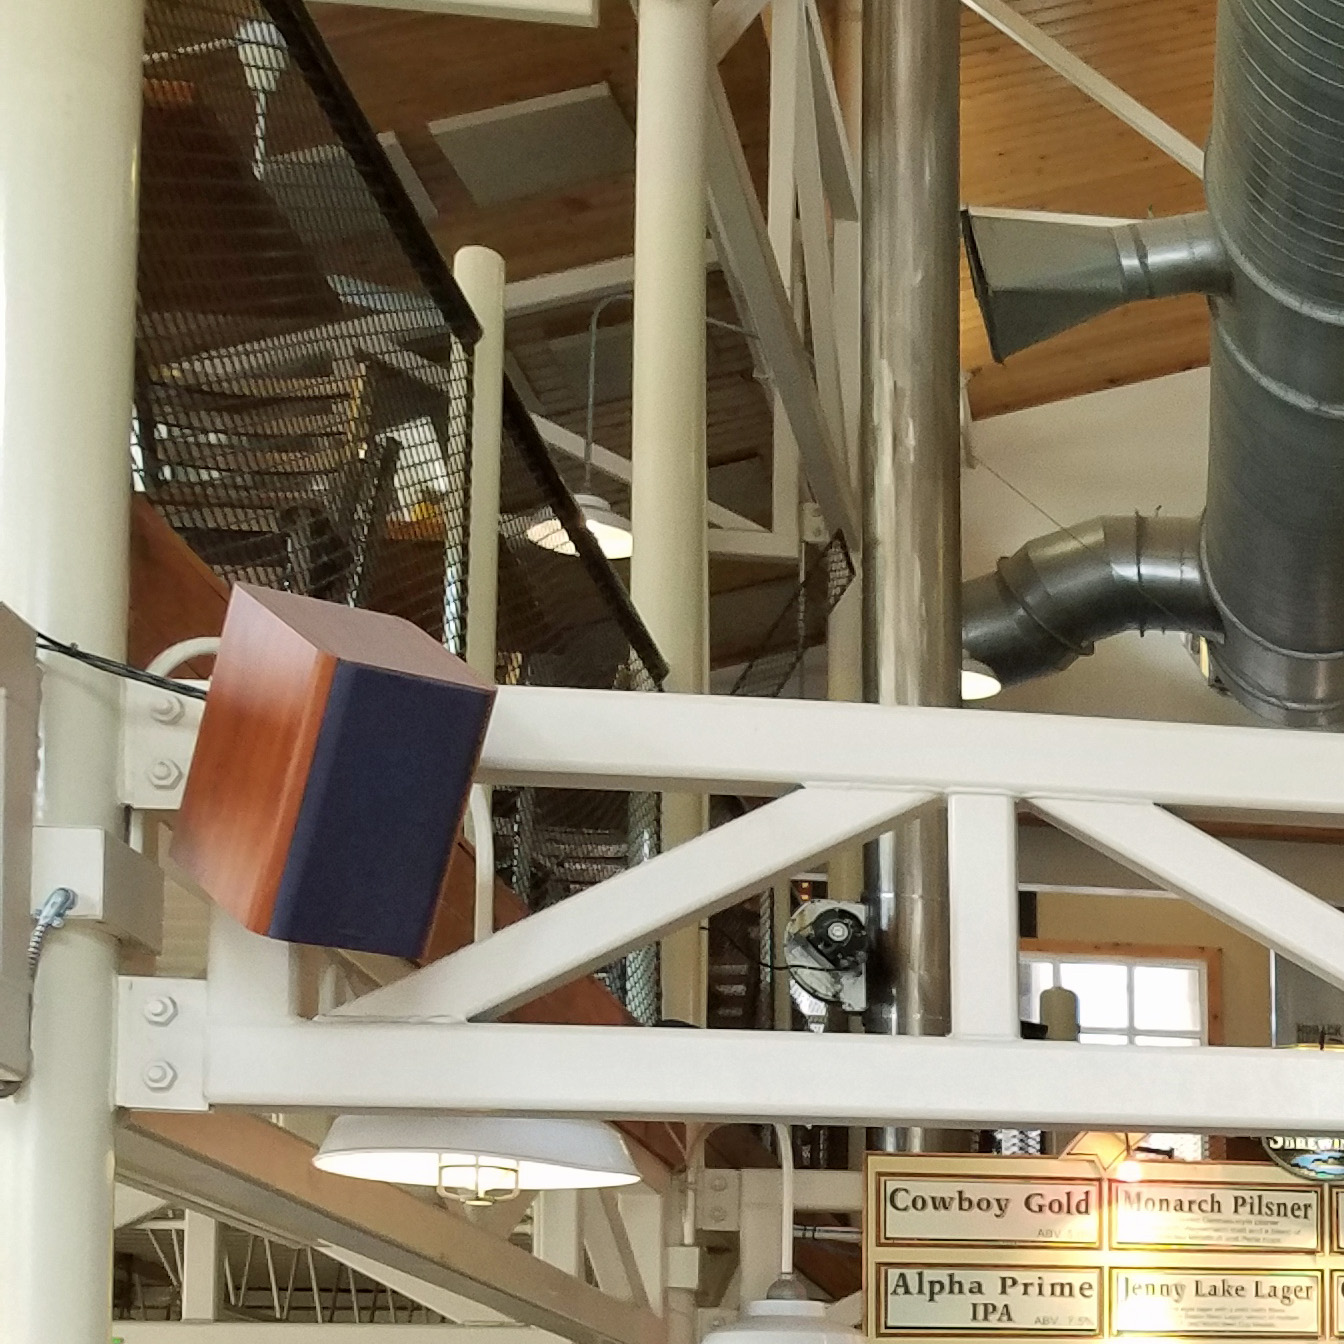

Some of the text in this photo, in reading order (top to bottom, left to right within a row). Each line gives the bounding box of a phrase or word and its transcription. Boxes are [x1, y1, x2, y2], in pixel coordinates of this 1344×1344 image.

[889, 1187, 1091, 1218] Cowboy Gold
[1123, 1190, 1314, 1220] Monarch Pilsner
[889, 1271, 1095, 1303] Alpha Prime
[1124, 1277, 1314, 1306] Jenny Lake Lager
[970, 1302, 1014, 1323] IPA
